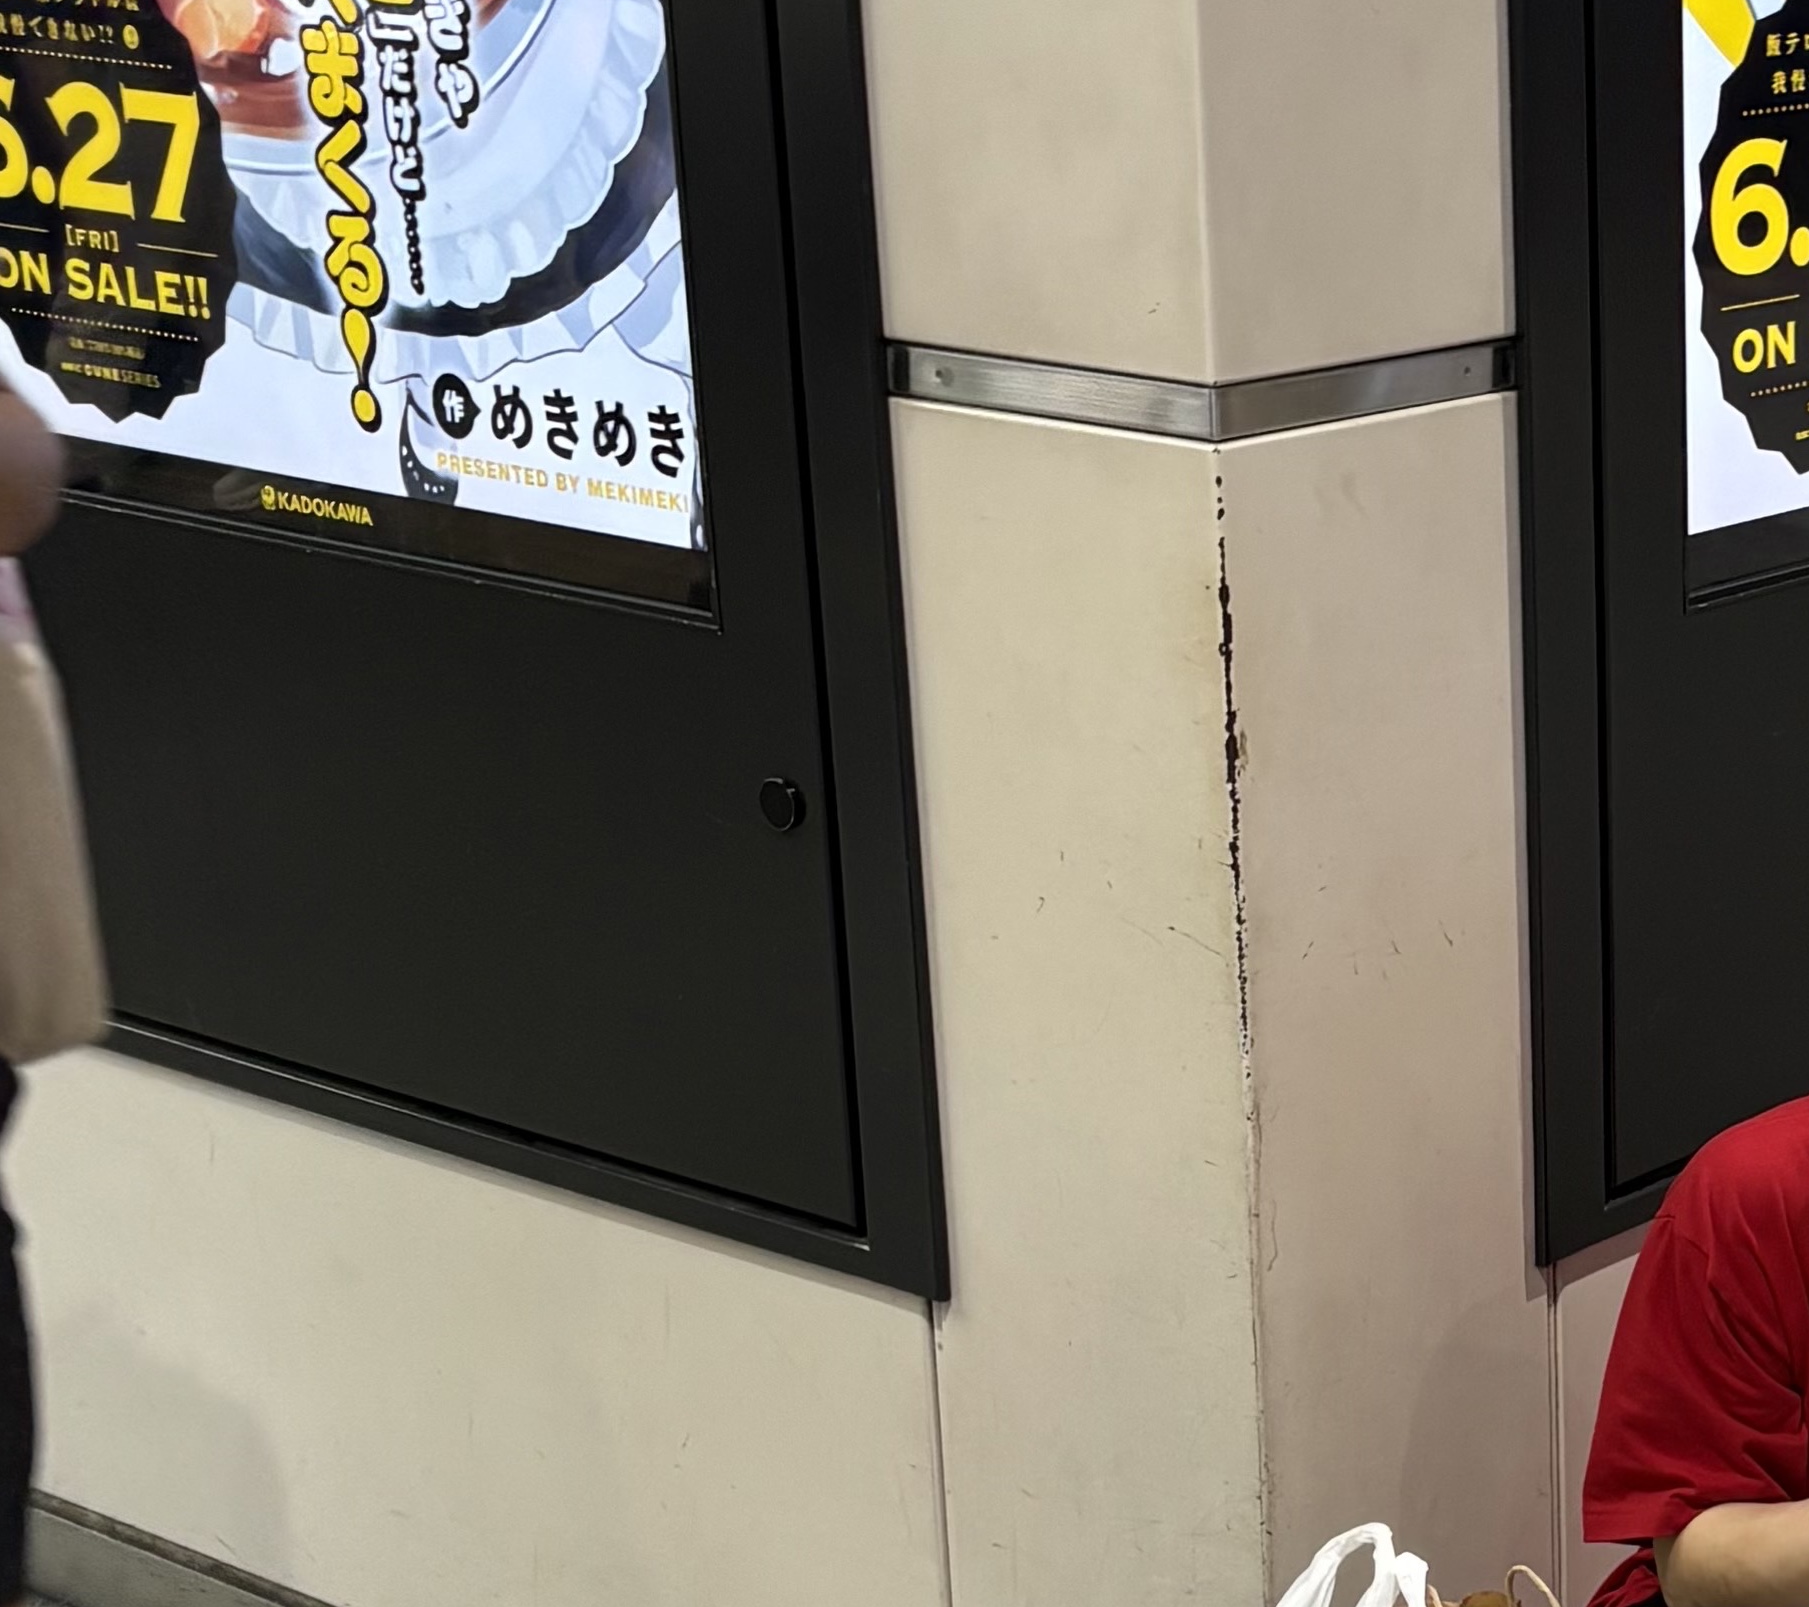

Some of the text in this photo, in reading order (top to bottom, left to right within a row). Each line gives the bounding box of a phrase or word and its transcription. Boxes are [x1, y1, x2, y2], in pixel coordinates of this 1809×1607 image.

[65, 257, 211, 320] SALE!!
[1732, 320, 1797, 374] ON
[490, 383, 687, 479] めきめき
[277, 490, 374, 527] KADOKAWA
[436, 452, 690, 514] PRESENTED BY MEKIMEKI
